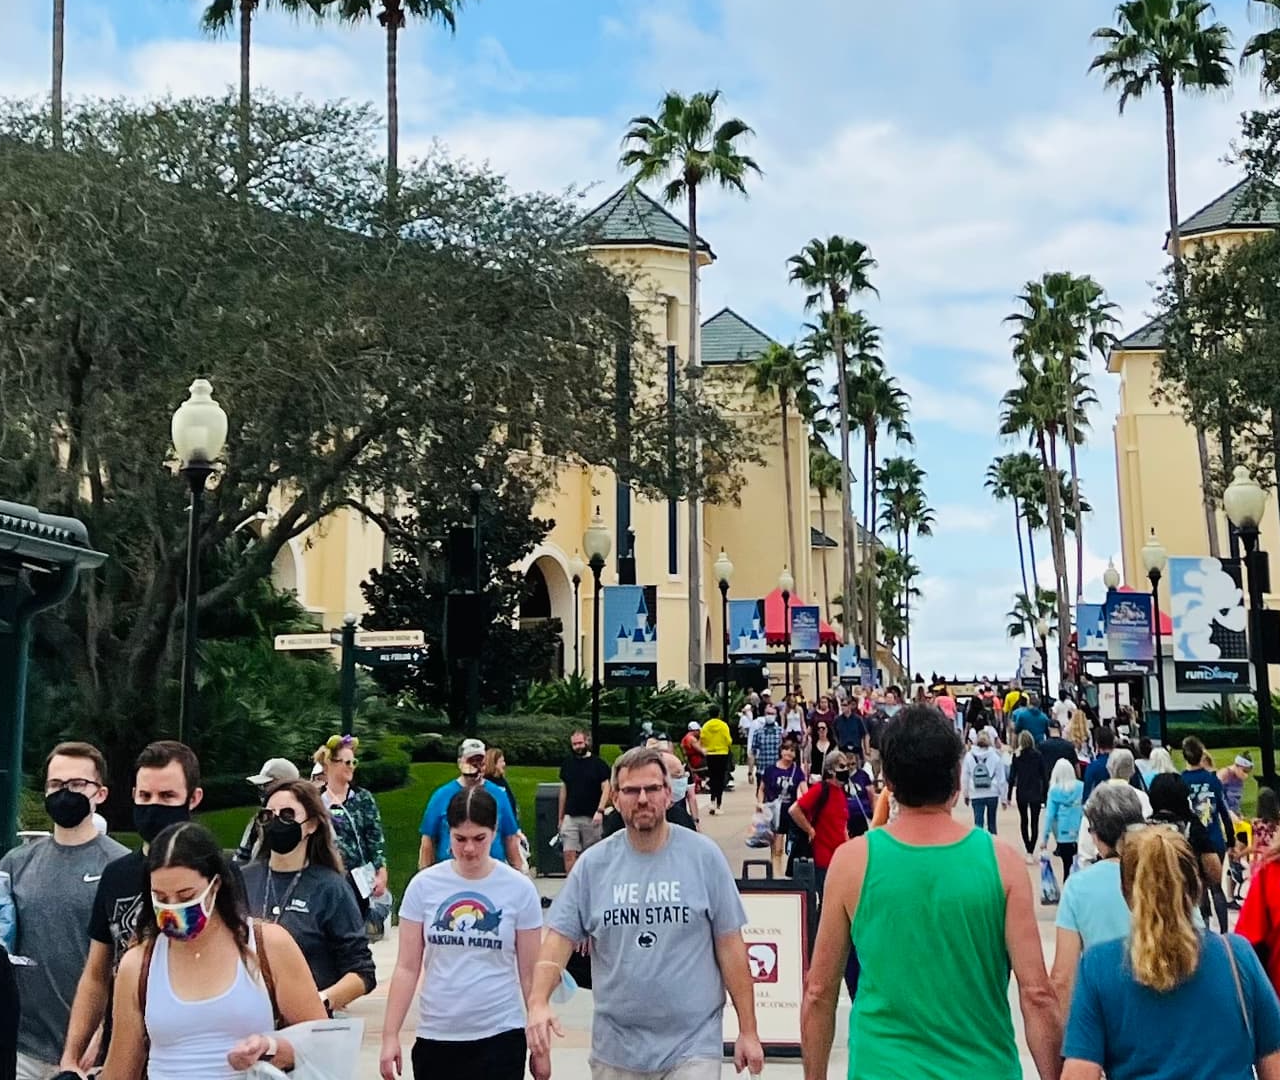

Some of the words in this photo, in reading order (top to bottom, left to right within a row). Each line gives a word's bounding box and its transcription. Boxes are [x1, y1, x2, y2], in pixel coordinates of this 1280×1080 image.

[613, 883, 639, 905] WE
[645, 881, 681, 904] ARE
[603, 907, 640, 926] PENN
[645, 906, 690, 925] STATE
